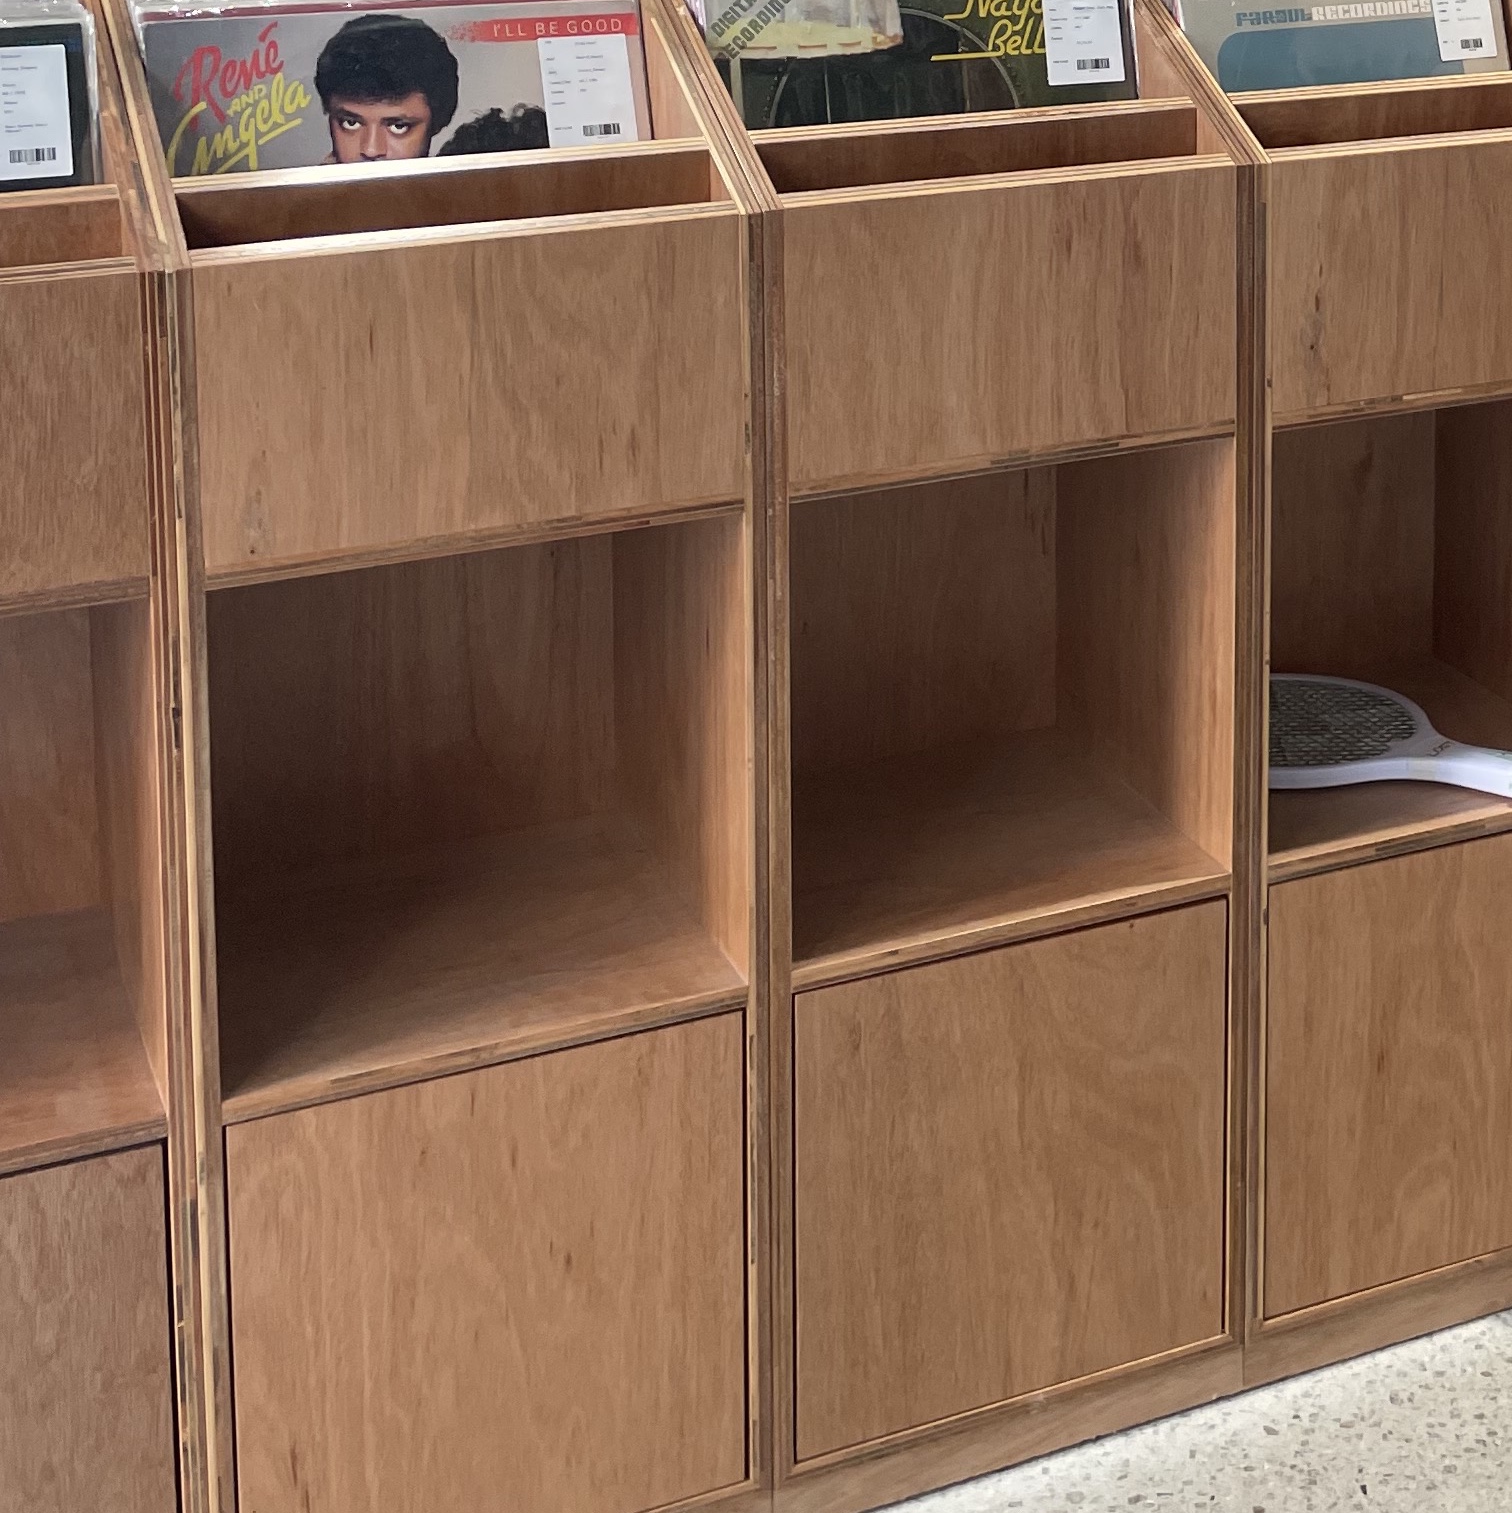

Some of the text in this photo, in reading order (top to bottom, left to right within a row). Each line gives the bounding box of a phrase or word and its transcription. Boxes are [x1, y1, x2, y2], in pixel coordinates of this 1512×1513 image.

[493, 18, 623, 38] I'LL BE GOOD
[173, 20, 285, 133] René
[227, 84, 267, 117] AND
